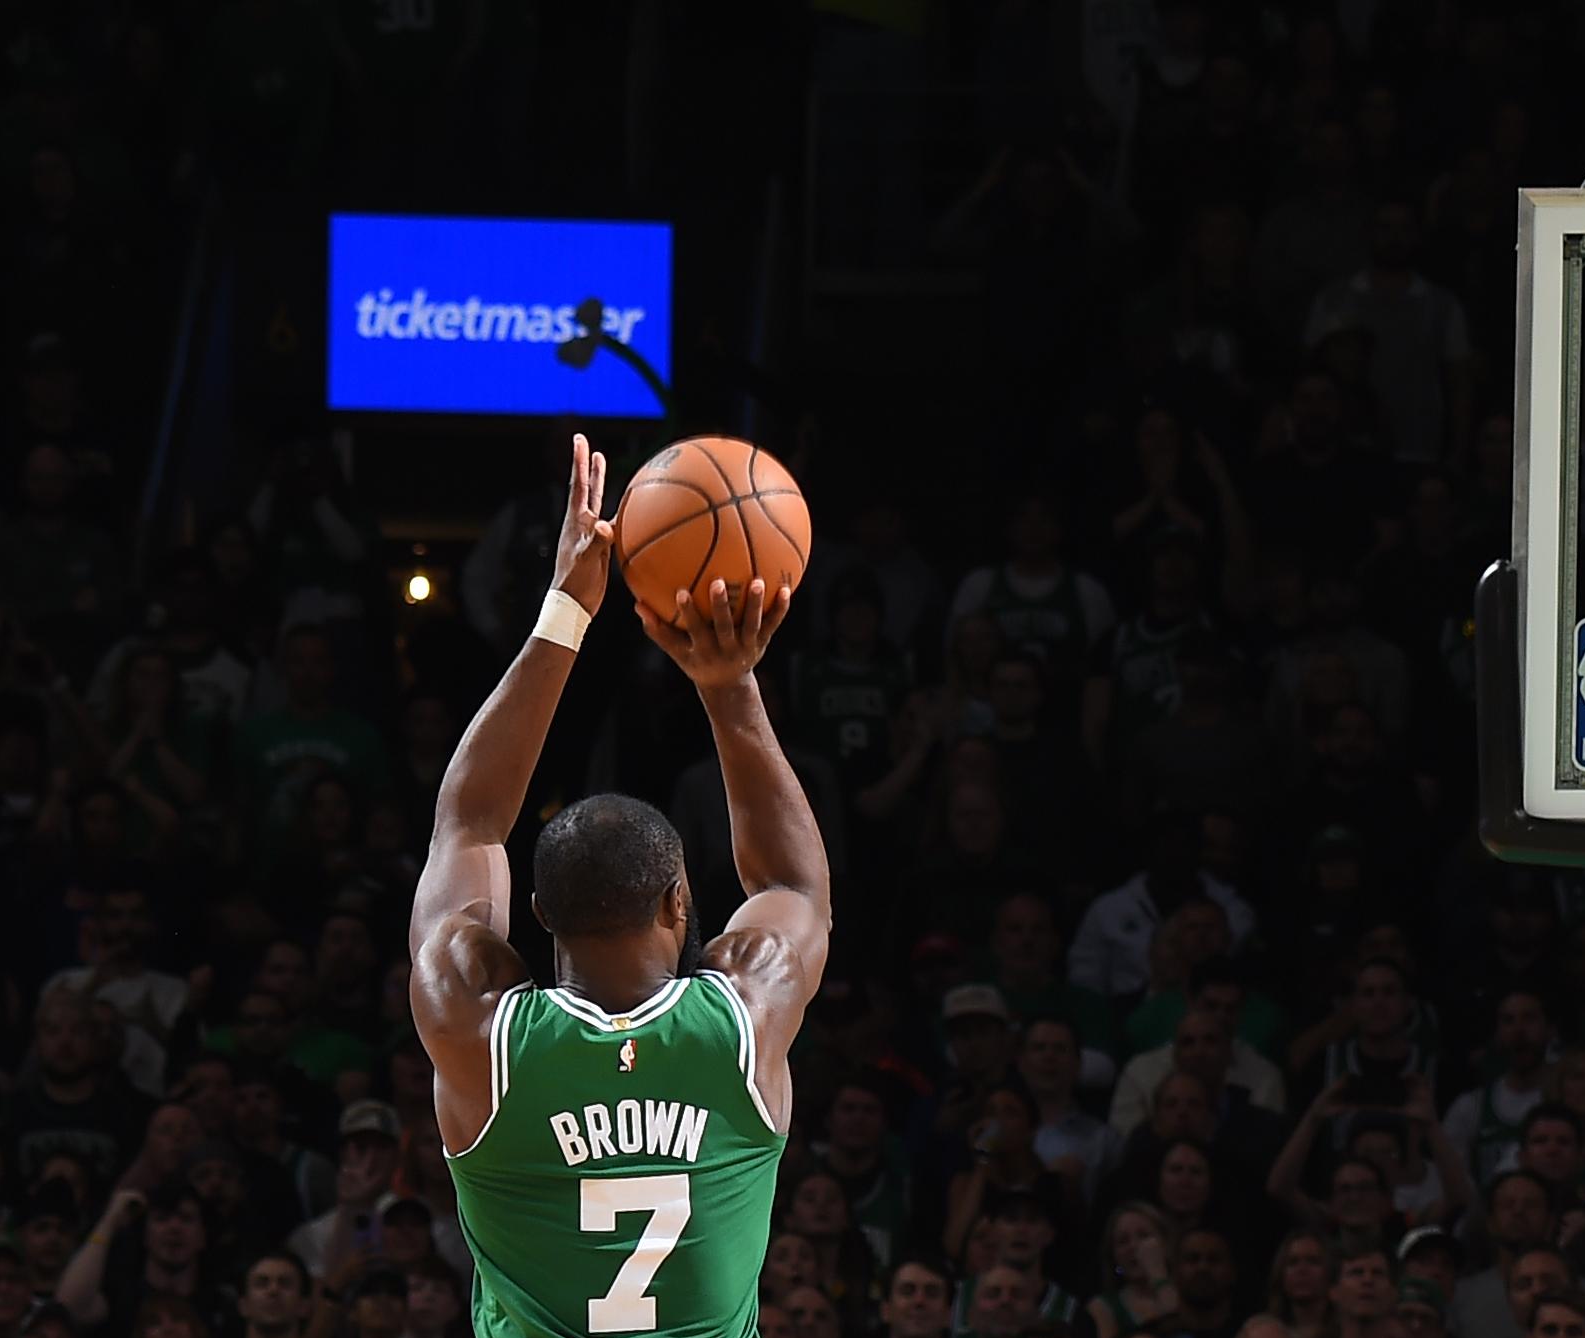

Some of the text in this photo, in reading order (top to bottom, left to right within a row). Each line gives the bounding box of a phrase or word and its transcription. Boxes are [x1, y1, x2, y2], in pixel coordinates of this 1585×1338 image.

[355, 287, 645, 345] ticketmaser
[549, 1099, 709, 1167] BROWN
[579, 1173, 691, 1333] 7
